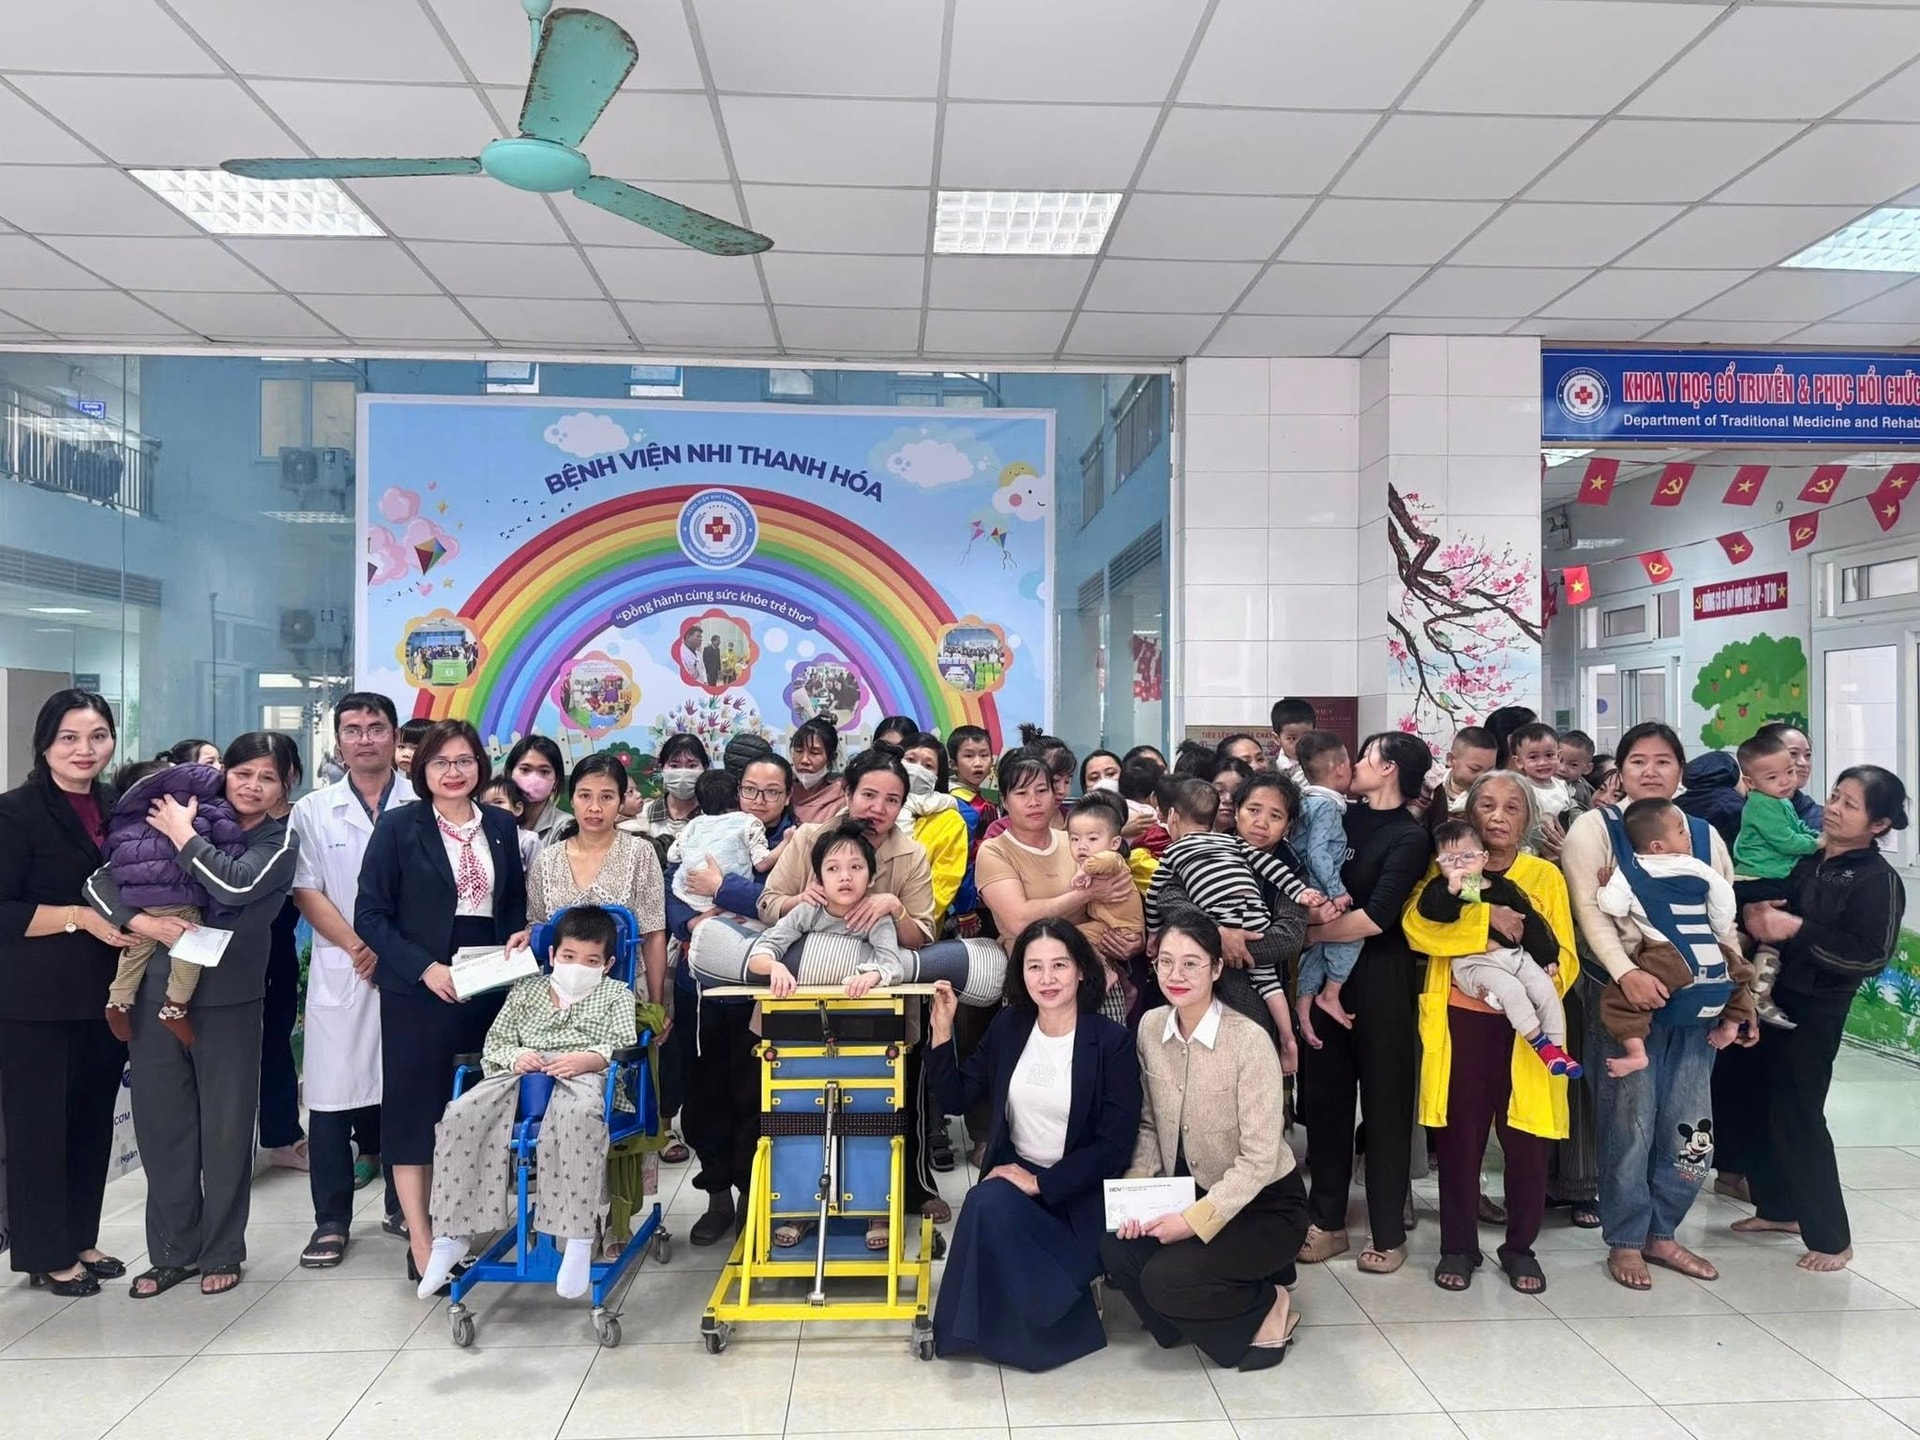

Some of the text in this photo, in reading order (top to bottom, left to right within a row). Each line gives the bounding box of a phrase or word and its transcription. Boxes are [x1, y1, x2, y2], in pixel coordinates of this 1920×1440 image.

[1623, 371, 1665, 403] KHOA
[1666, 372, 1678, 403] Y
[1679, 371, 1712, 410] HỌC
[1714, 361, 1736, 404] CỔ
[1737, 364, 1795, 404] TRUYỀN
[1797, 373, 1811, 404] &
[1813, 373, 1854, 411] PHỤC
[1856, 365, 1882, 405] HỒI
[1623, 414, 1700, 429] Department
[1704, 414, 1718, 426] of
[1721, 414, 1789, 427] Traditional
[1793, 415, 1851, 428] Medicine
[1855, 416, 1878, 428] and
[544, 442, 882, 503] BỆNH VIỆN NHI THANH HÓA
[653, 592, 683, 609] hành
[685, 589, 714, 602] cùng
[716, 588, 738, 601] sức
[740, 591, 768, 607] khỏe
[770, 600, 787, 613] trẻ
